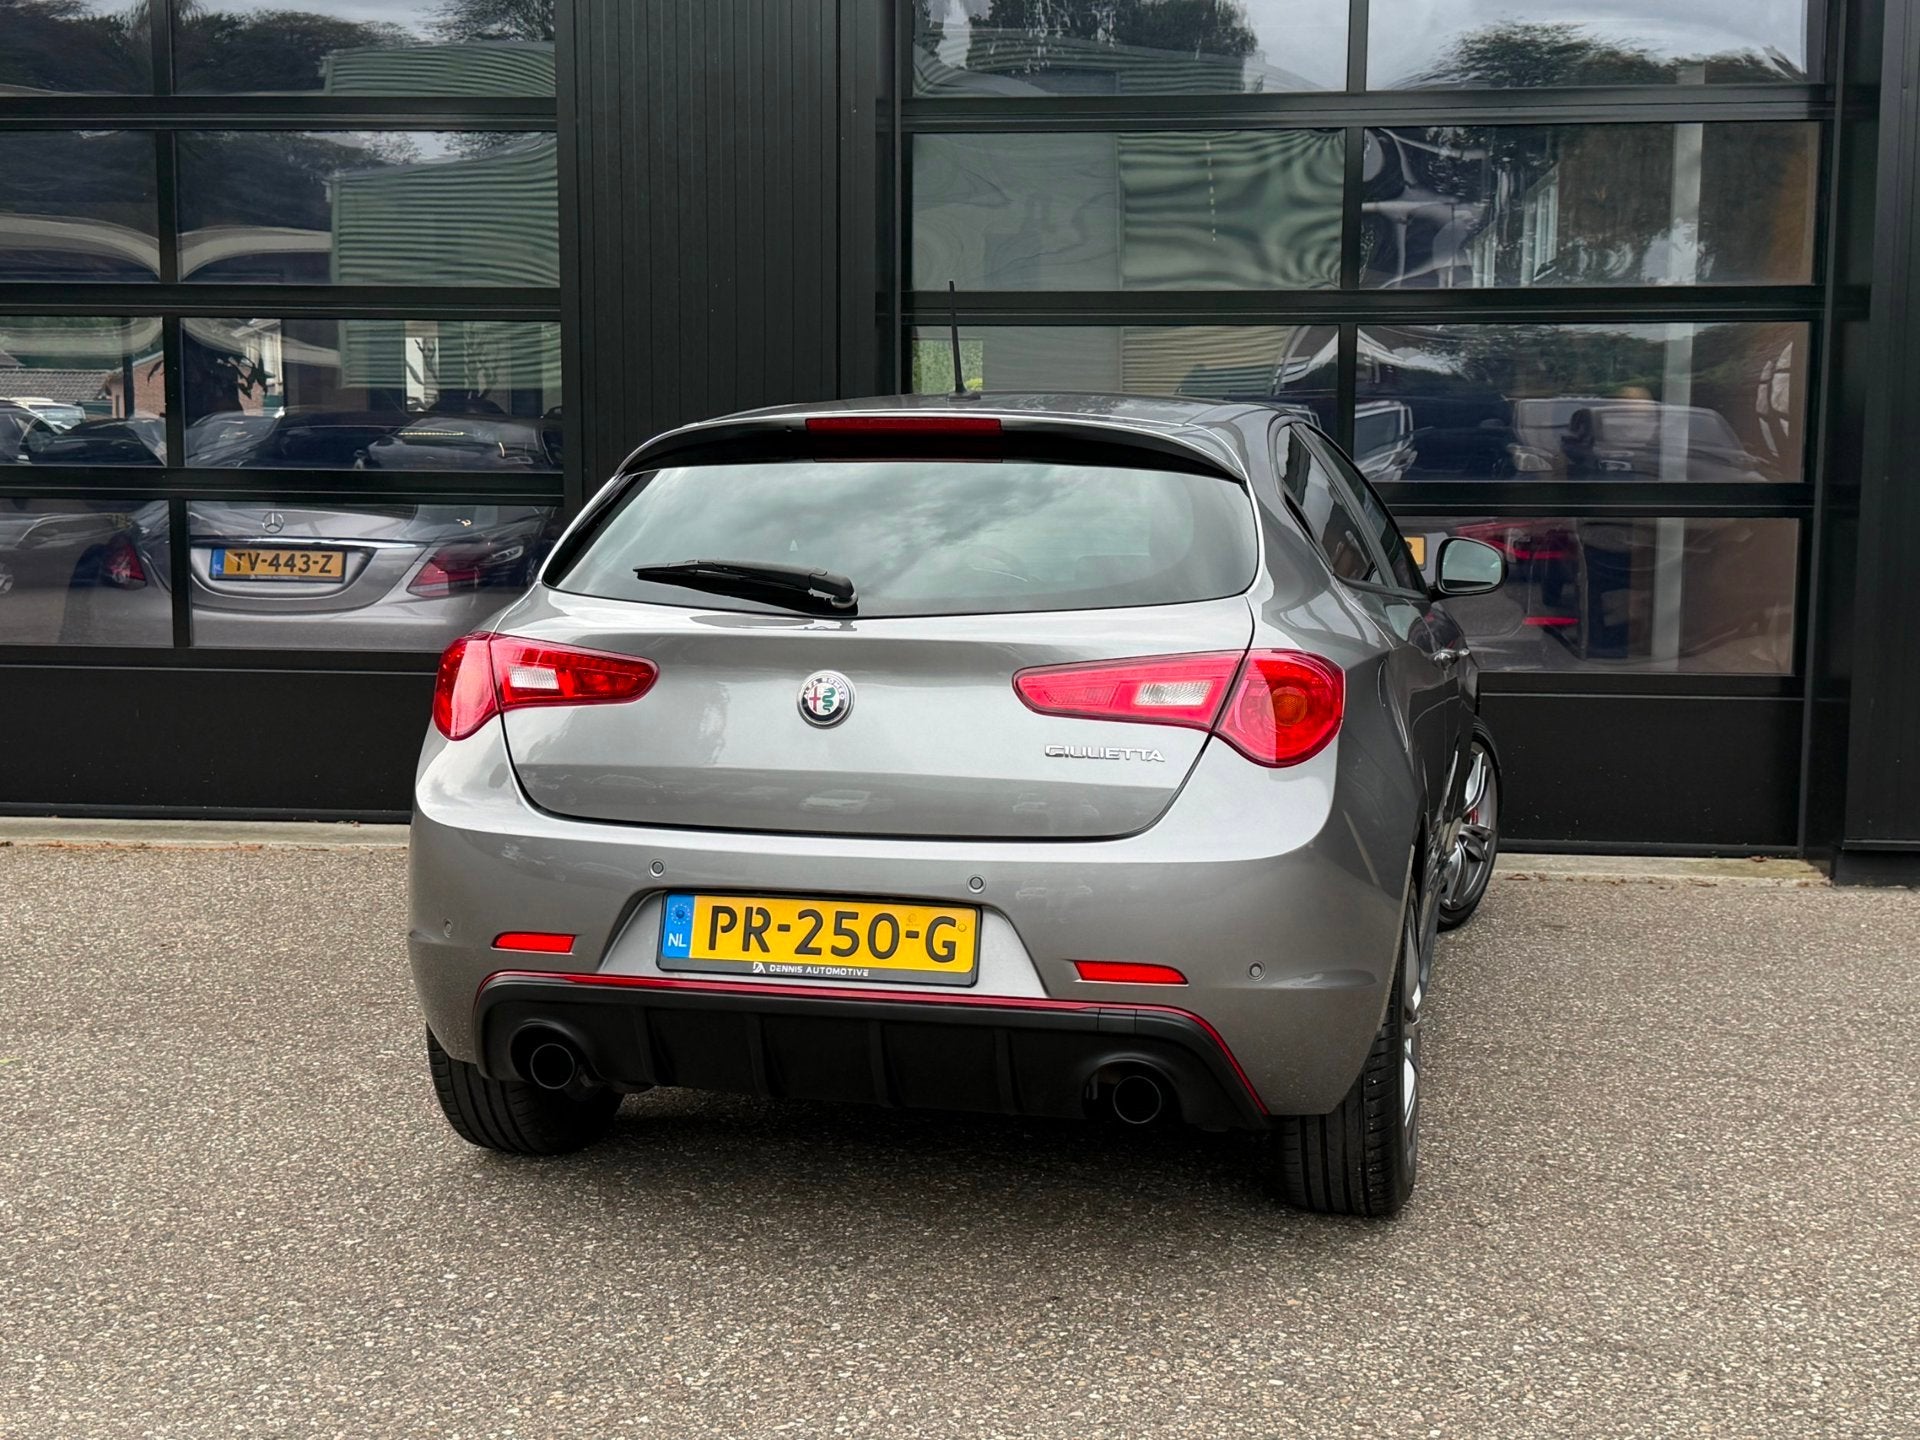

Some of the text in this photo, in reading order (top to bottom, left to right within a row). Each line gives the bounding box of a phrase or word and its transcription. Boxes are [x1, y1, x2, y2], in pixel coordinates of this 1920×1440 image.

[233, 552, 334, 574] TV-443-Z
[1045, 745, 1166, 762] GIULIETTA
[667, 933, 687, 948] NL
[707, 904, 958, 964] PR-250-G
[769, 964, 803, 974] DENNIS
[805, 966, 870, 977] AUTOMOTIVE
